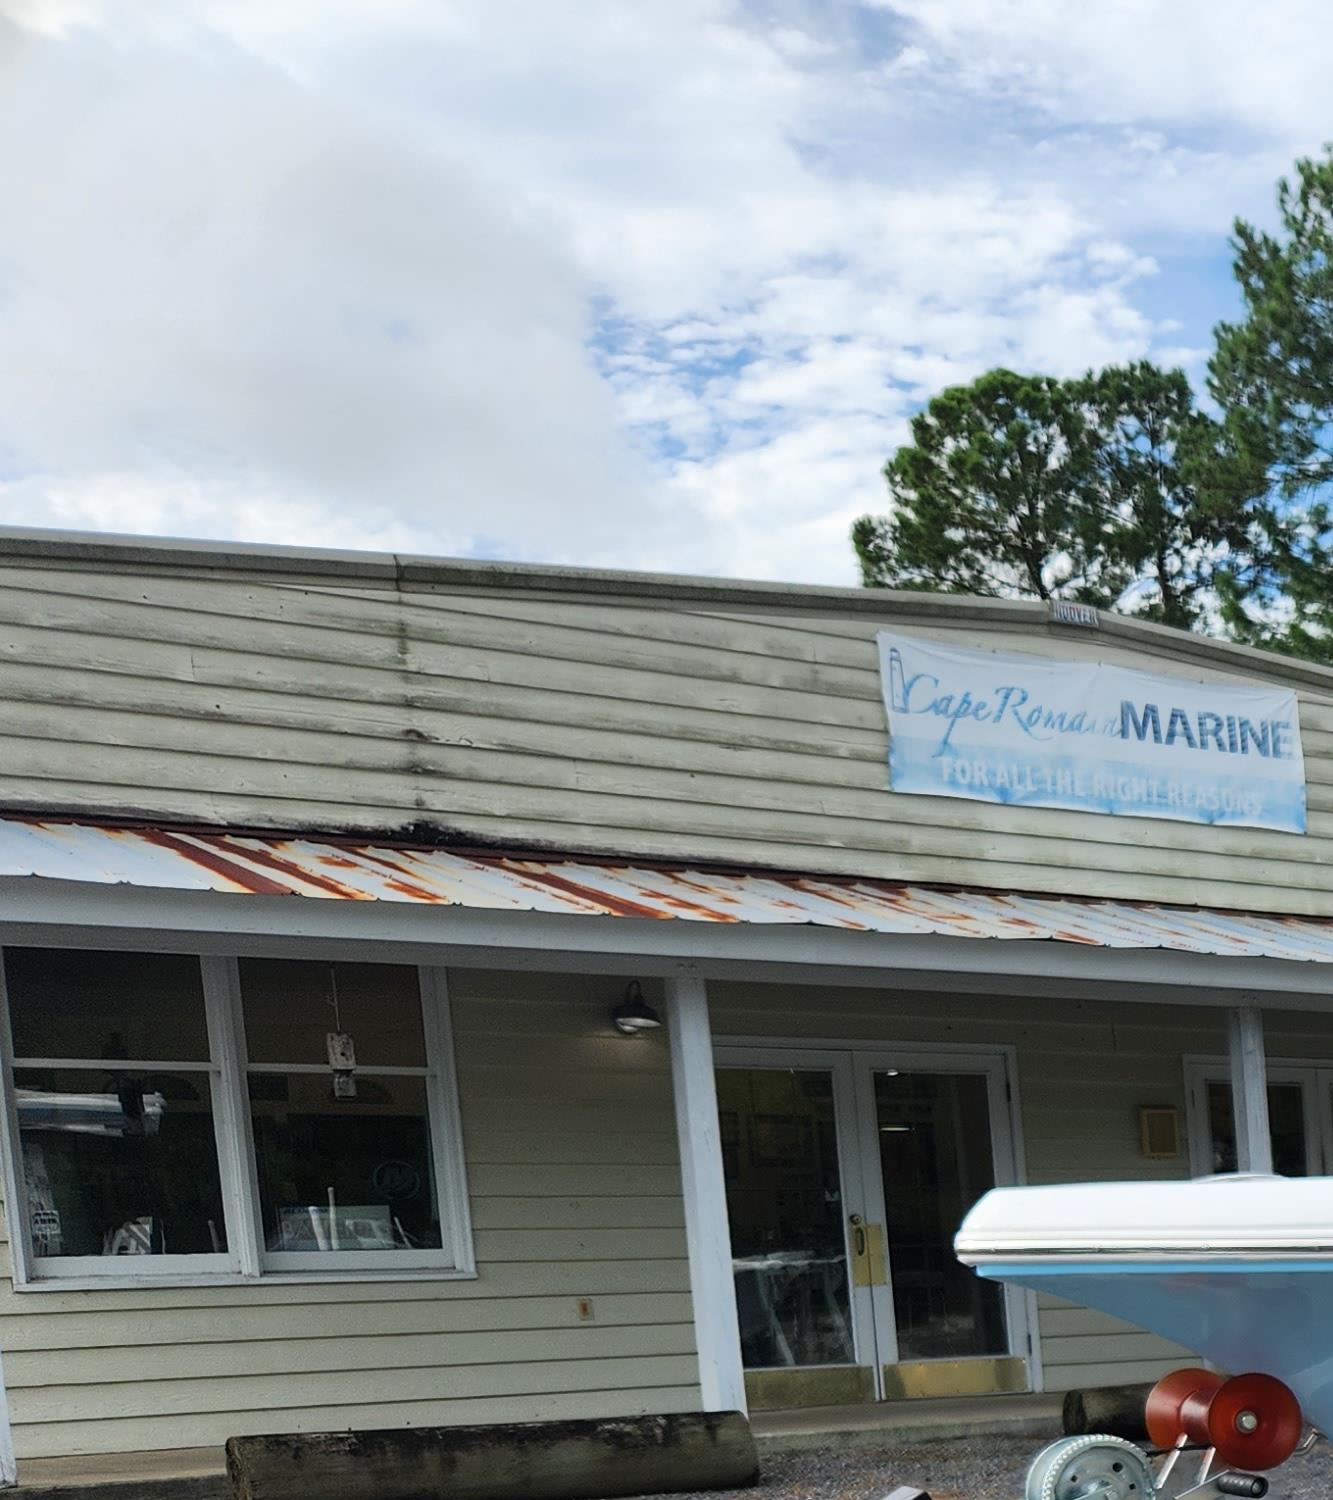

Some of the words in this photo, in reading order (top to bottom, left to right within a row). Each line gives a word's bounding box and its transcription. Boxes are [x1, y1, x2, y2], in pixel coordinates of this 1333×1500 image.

[903, 673, 993, 758] Cape
[994, 686, 1121, 742] Romain
[1120, 699, 1295, 760] MARINE
[940, 755, 989, 786] FOR
[994, 762, 1038, 793] ALL
[1044, 767, 1088, 798] THE
[1092, 771, 1162, 804] RIGHT
[1167, 782, 1264, 817] REASONS
